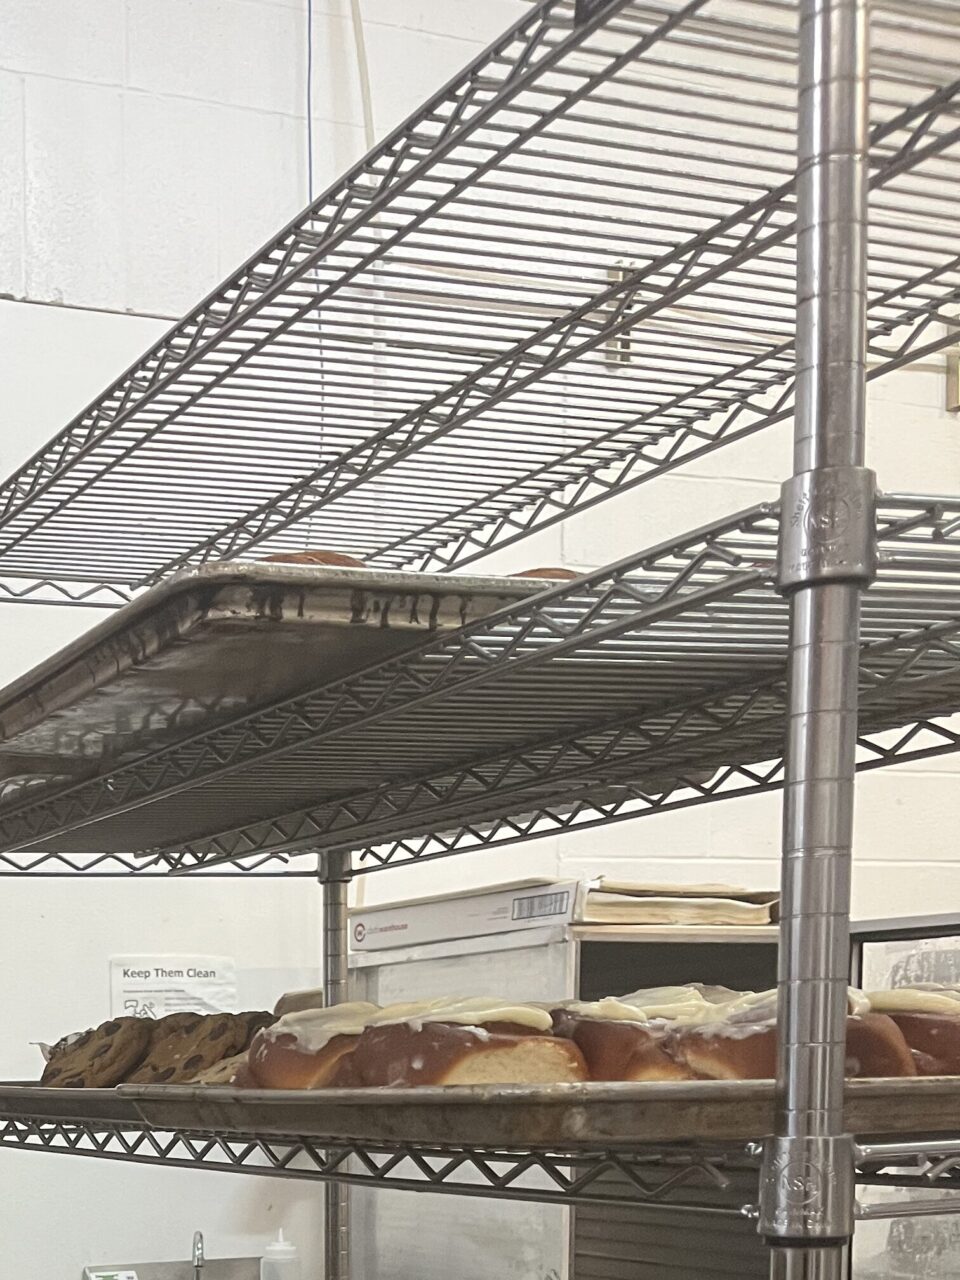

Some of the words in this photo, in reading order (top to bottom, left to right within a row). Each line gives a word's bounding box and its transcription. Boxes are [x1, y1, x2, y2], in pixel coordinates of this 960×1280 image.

[122, 968, 151, 979] Keep
[154, 968, 184, 978] Them
[186, 968, 216, 979] Clean
